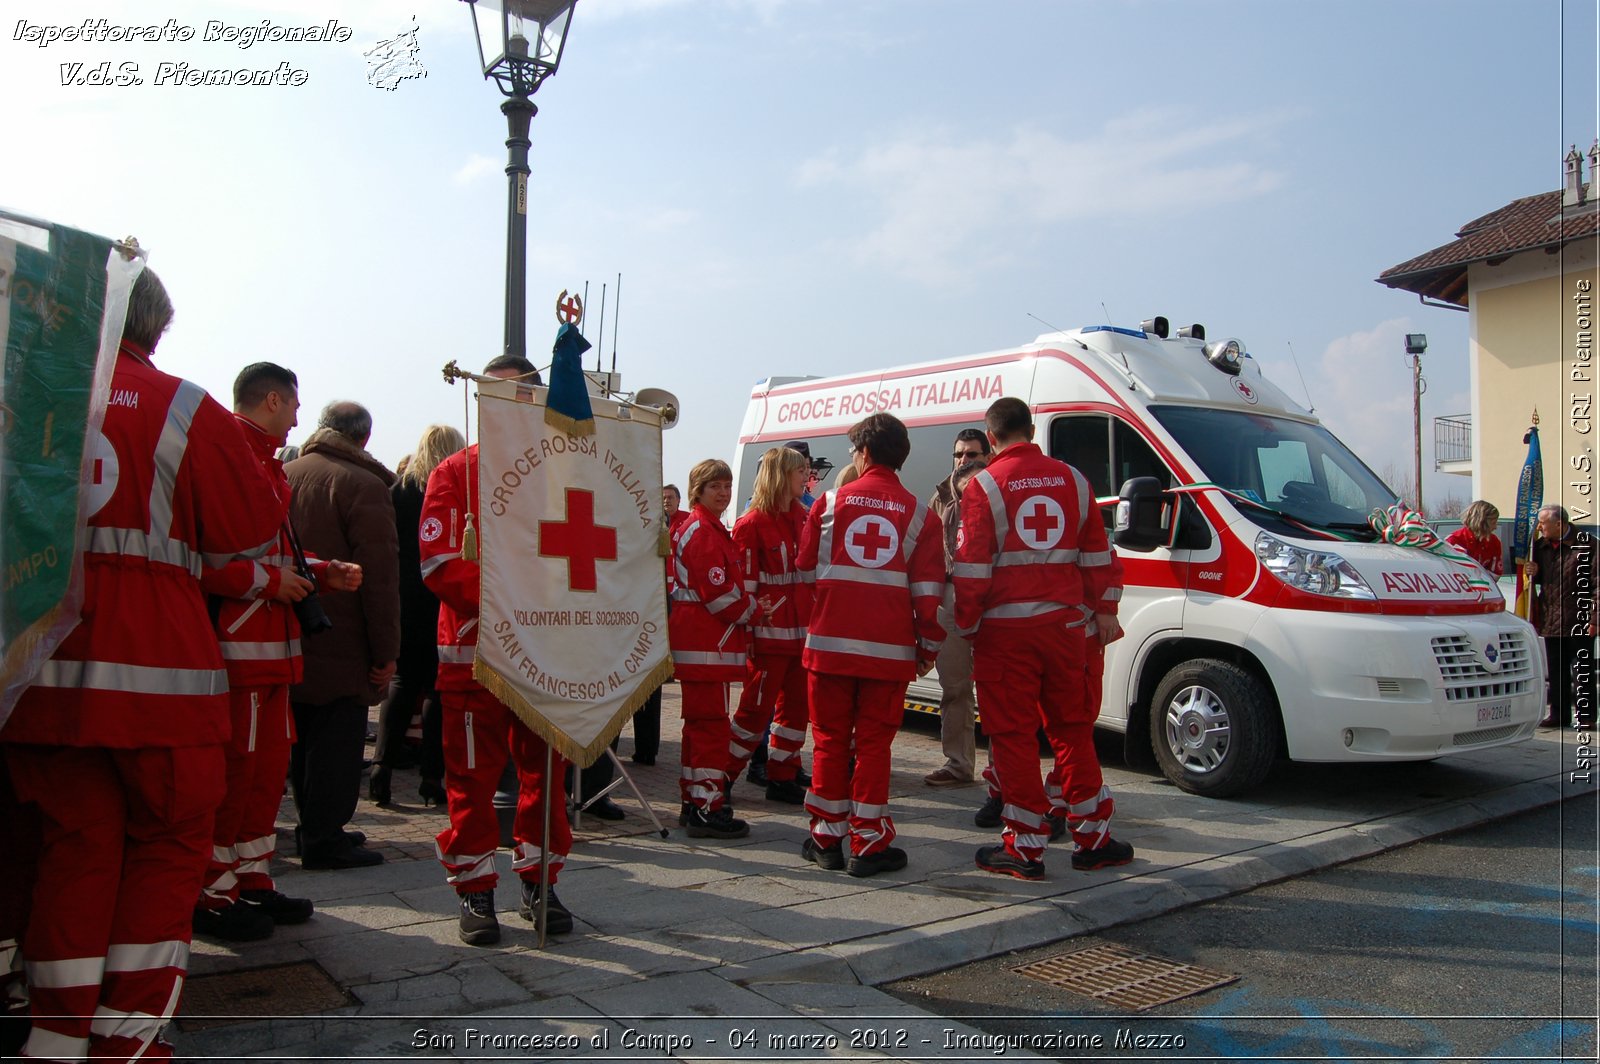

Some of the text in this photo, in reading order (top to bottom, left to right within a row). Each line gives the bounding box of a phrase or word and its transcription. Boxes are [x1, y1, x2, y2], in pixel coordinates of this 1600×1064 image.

[778, 374, 1004, 423] CROCE ROSSA ITALIANA
[490, 435, 653, 529] CROCE ROSSA ITALIANA
[1008, 476, 1066, 492] CROCE ROSSA ITALIANA
[1519, 464, 1533, 504] FRANCESCO
[845, 495, 906, 513] CROCE ROSSA ITALIANA
[1198, 571, 1223, 581] ODONE
[514, 610, 640, 626] VOLONTARI DEL SOCCORSO
[494, 620, 657, 700] SAN FRANCESCO AL CAMPO
